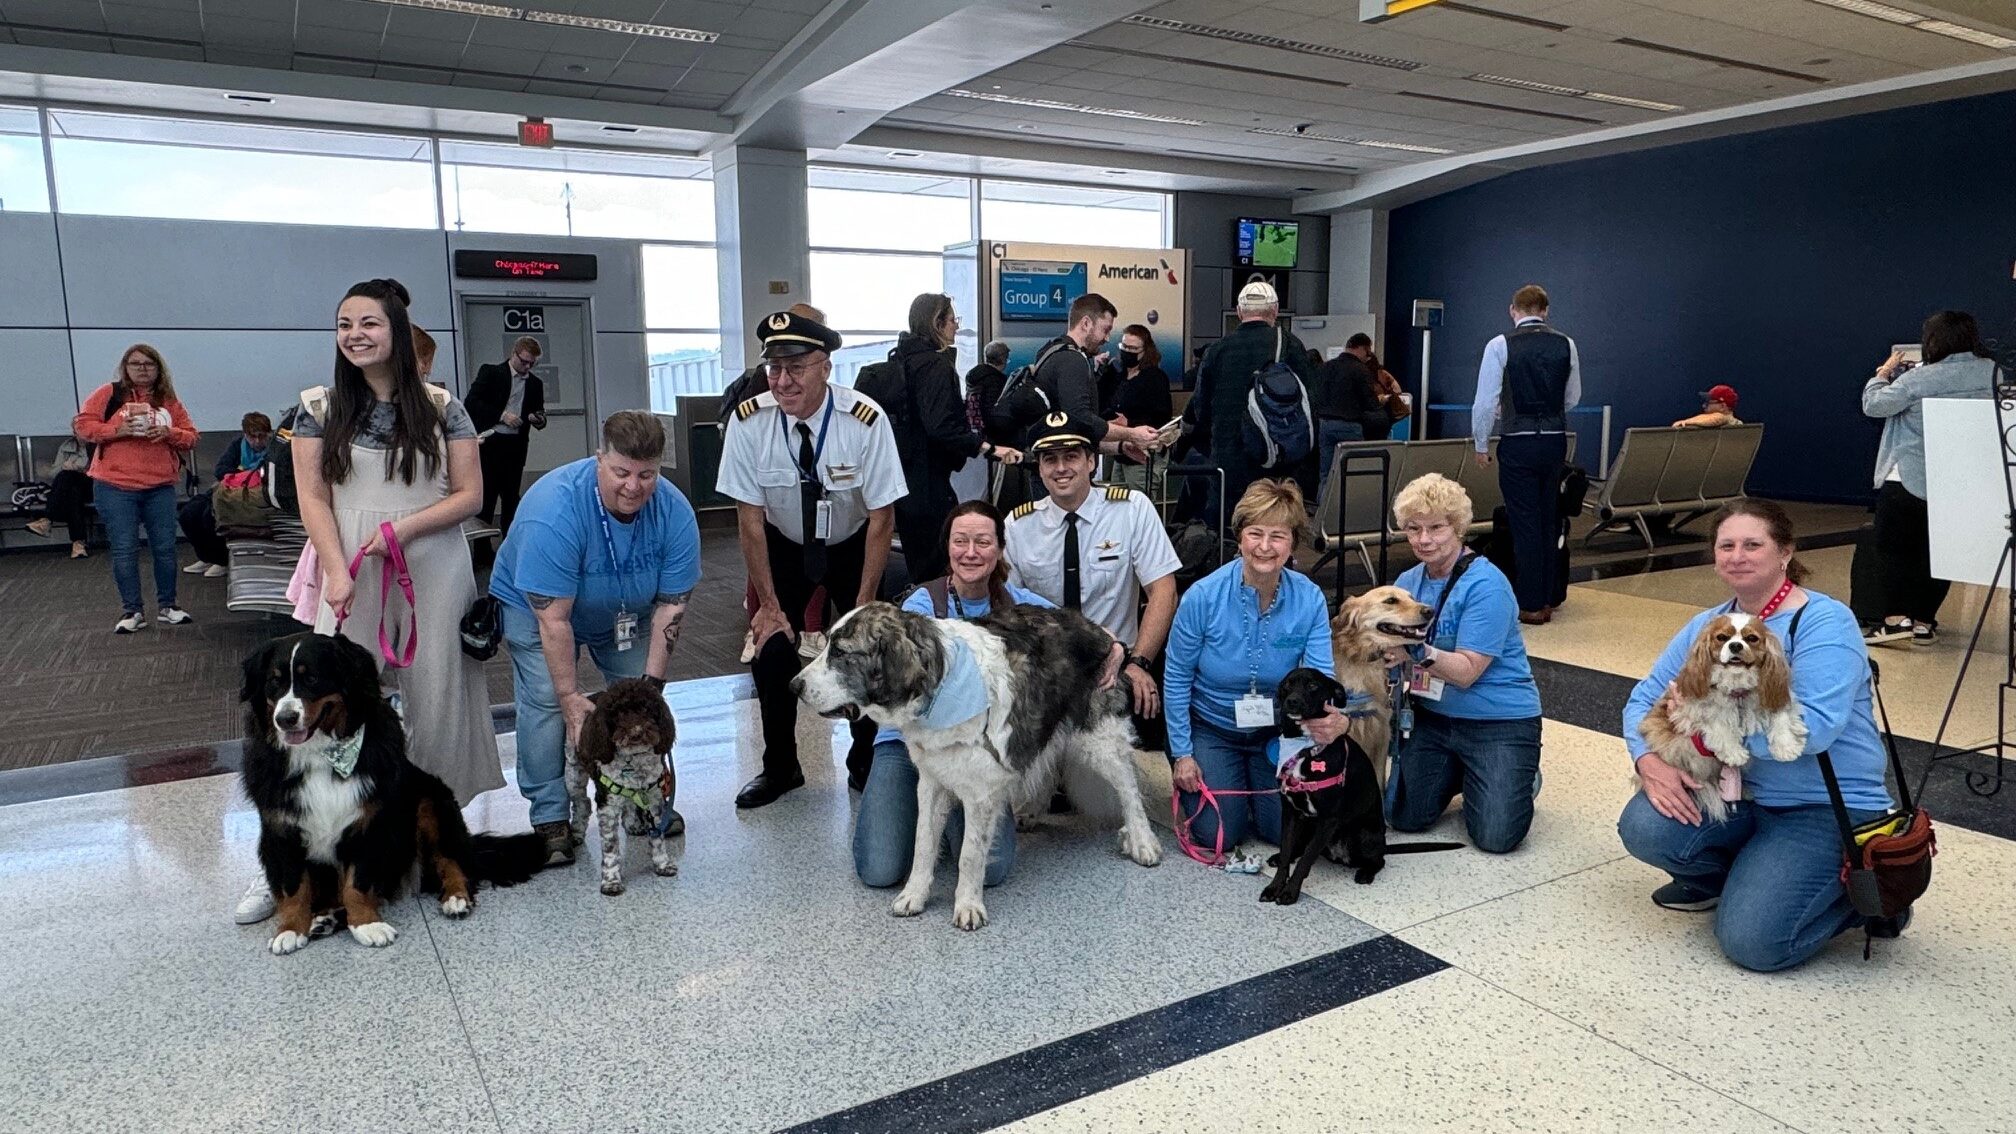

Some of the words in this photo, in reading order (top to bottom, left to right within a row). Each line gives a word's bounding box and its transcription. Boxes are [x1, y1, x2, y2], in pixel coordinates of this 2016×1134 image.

[992, 243, 1007, 258] C1
[1098, 264, 1159, 280] American
[1004, 289, 1047, 308] Group
[1053, 288, 1062, 303] 4
[504, 309, 544, 329] C1a
